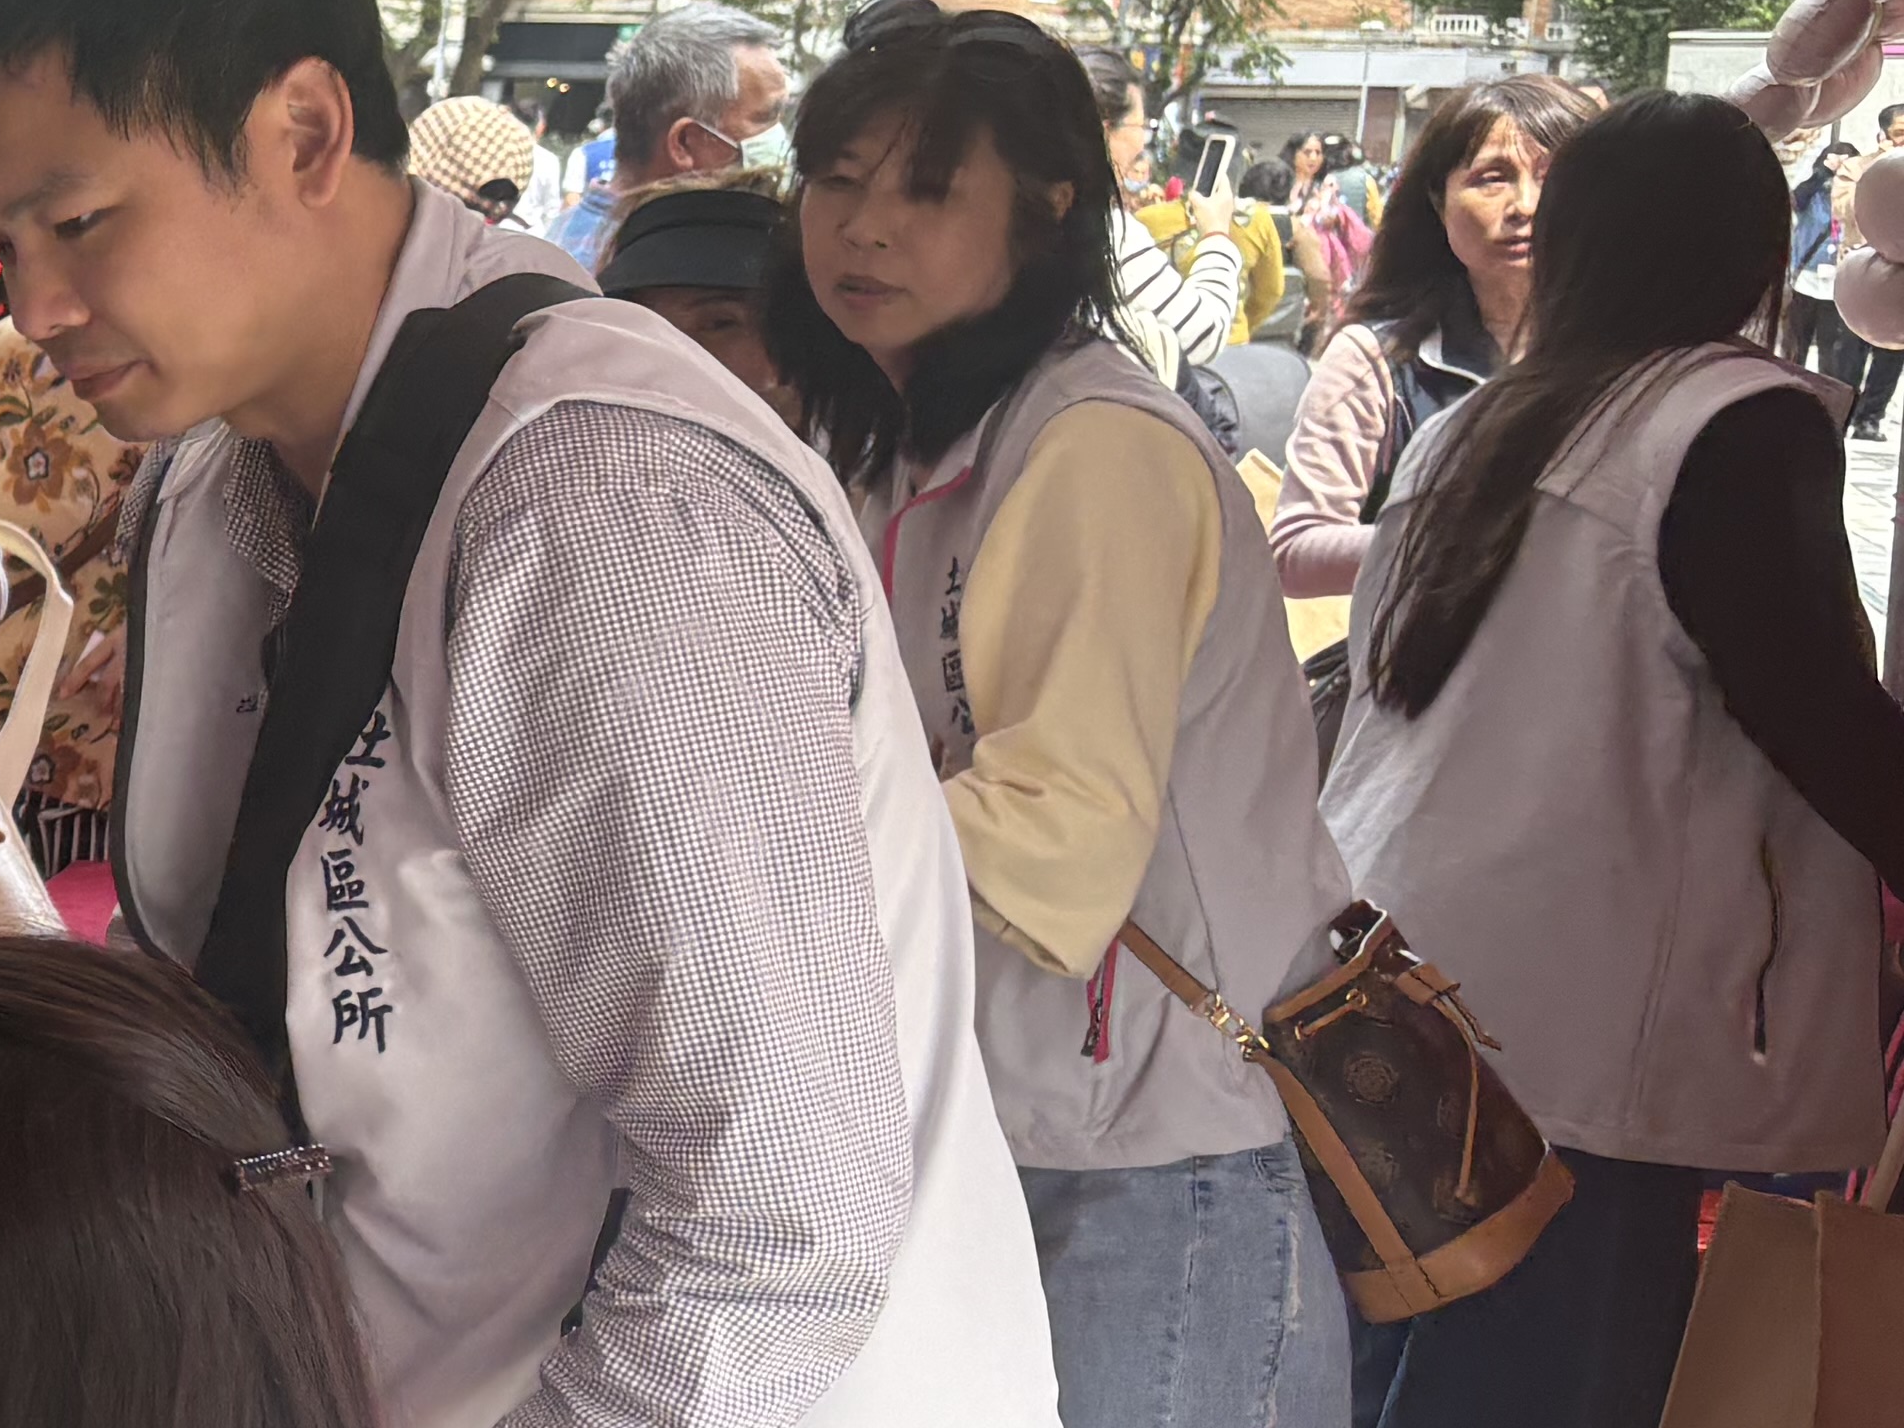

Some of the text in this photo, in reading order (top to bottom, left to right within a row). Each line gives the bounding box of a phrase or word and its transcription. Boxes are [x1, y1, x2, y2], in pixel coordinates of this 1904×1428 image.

[319, 710, 393, 1054] 土城區公所
